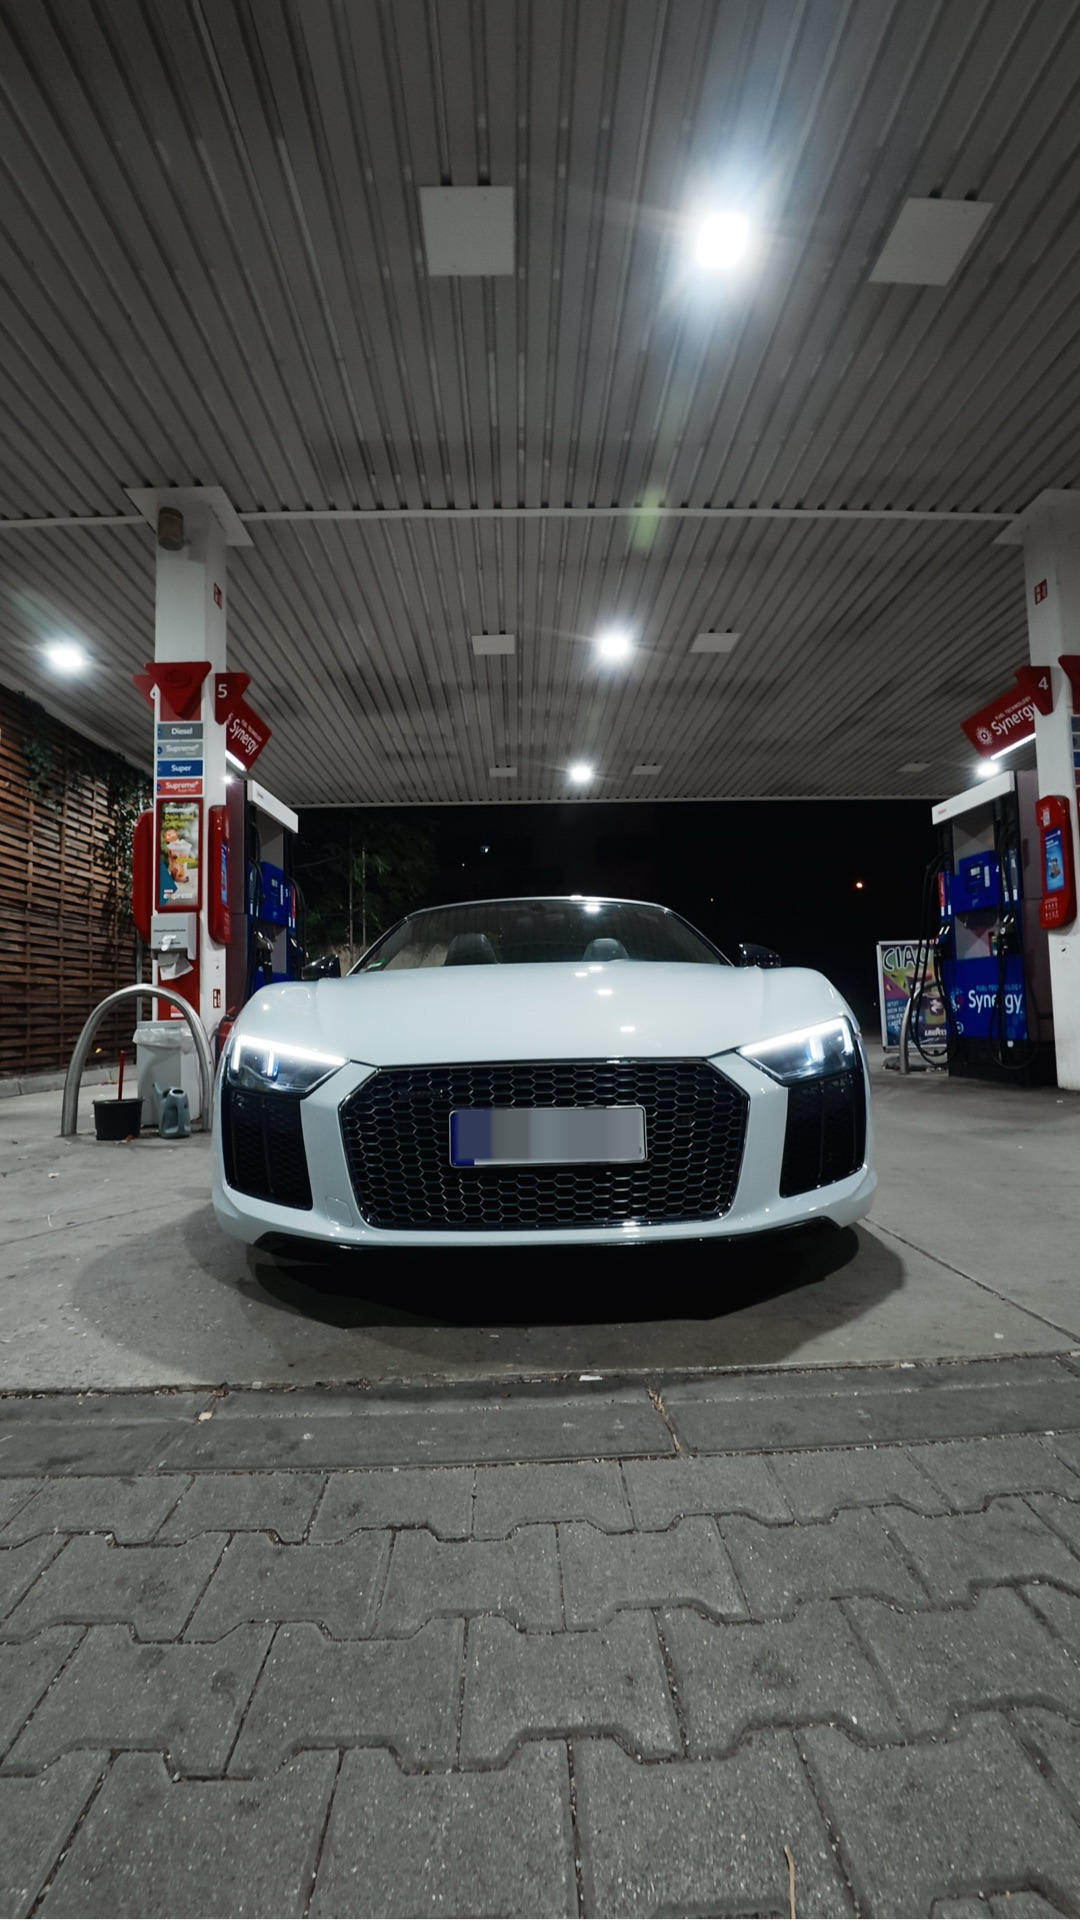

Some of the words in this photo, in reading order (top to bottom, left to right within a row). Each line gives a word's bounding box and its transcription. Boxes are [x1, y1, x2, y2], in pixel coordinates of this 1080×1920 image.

[218, 683, 228, 698] 5
[1038, 676, 1049, 691] 4
[990, 701, 1036, 736] Synergy
[171, 727, 193, 735] Diesel
[229, 718, 259, 756] Synergy
[171, 764, 192, 773] Super
[968, 989, 1023, 1015] Synegy
